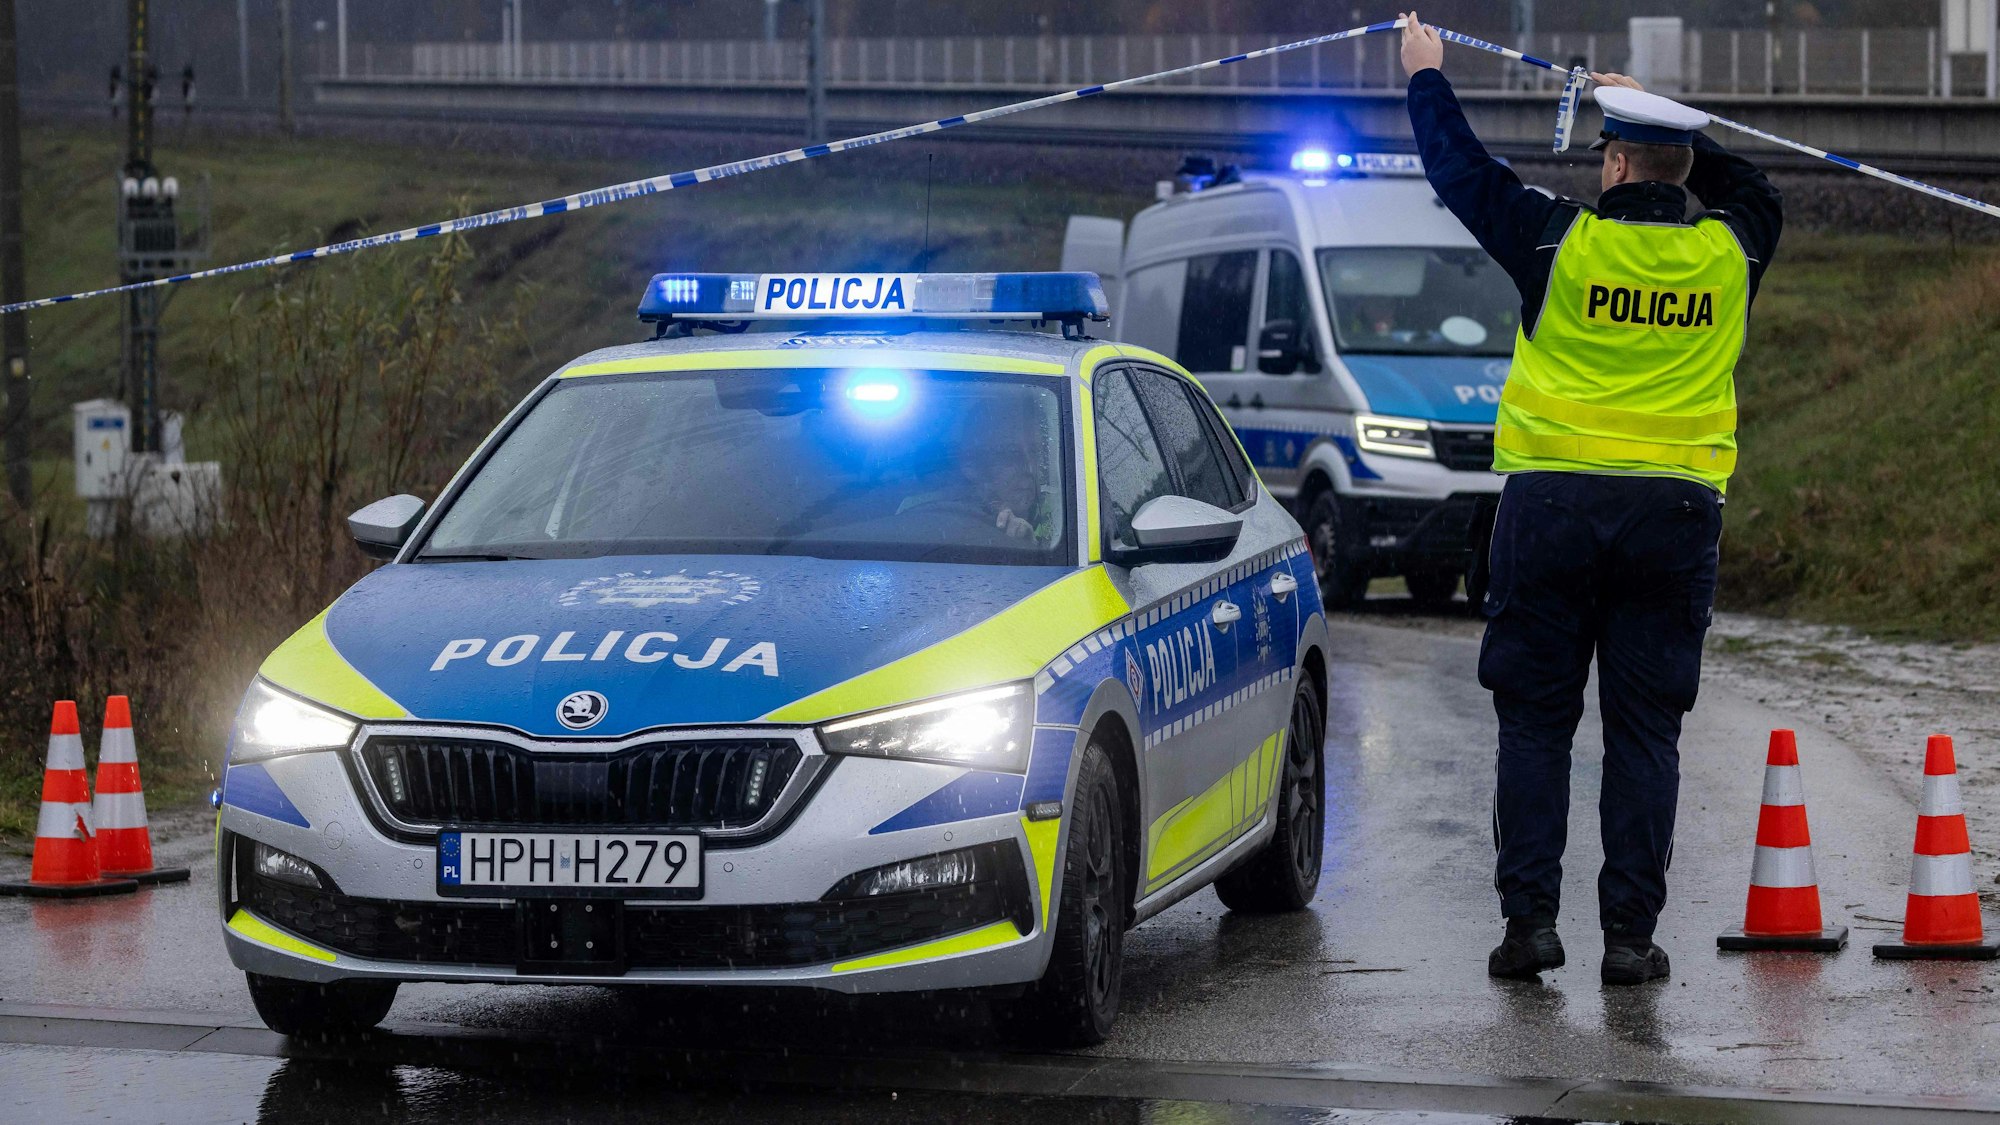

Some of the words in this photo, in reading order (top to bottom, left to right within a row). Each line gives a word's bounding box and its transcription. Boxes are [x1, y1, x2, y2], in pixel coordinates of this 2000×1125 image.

[764, 277, 906, 310] POLICJA
[1588, 284, 1713, 327] POLICJA
[1453, 385, 1504, 404] PO
[429, 630, 779, 677] POLICJA
[1146, 619, 1216, 715] POLICJA
[443, 865, 459, 878] PL
[470, 838, 555, 882] HPH
[574, 839, 687, 884] H279
